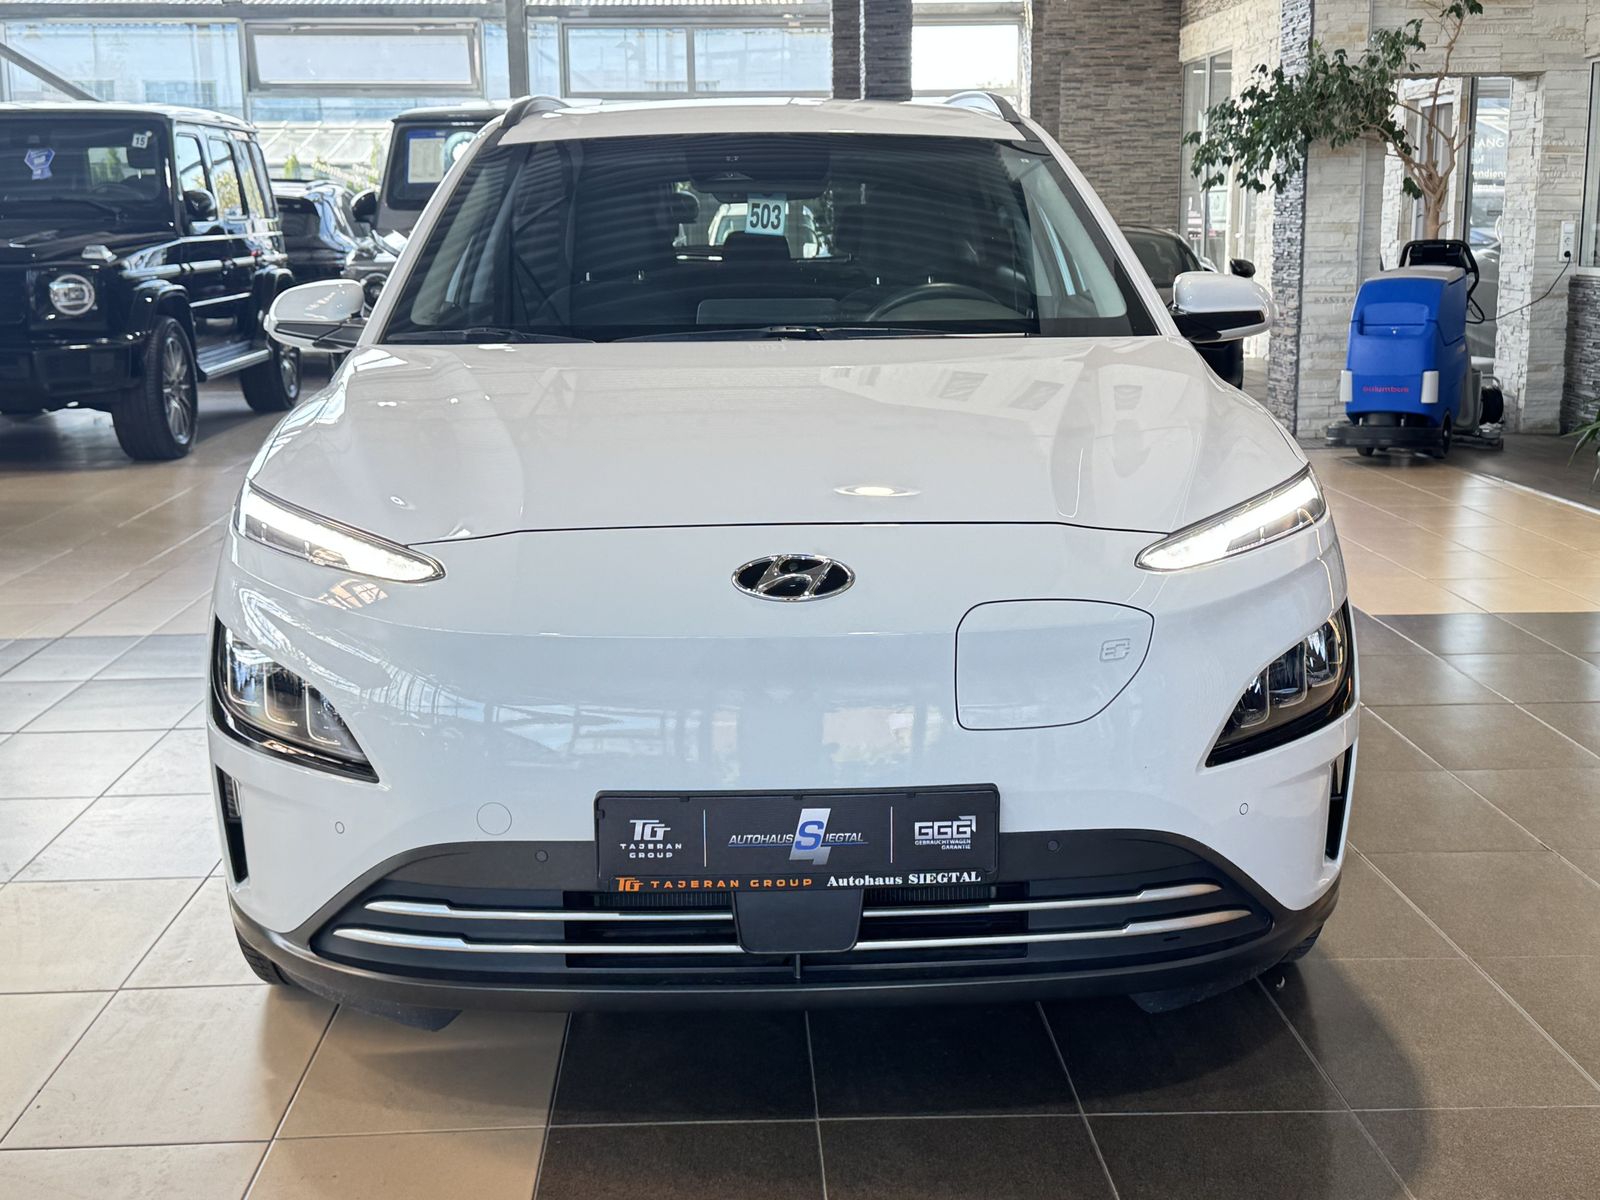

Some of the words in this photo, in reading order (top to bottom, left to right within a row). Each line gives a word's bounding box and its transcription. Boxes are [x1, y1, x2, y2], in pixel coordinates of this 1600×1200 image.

[135, 136, 146, 146] 15
[749, 202, 782, 230] 503
[914, 819, 972, 840] GGG
[728, 833, 795, 845] AUTOHAUS
[914, 838, 971, 846] GEBRAUCHTWAGEN
[650, 879, 740, 889] TAJERAN
[749, 878, 813, 888] GROUP
[826, 874, 903, 887] Autohaus
[907, 871, 982, 885] SIEGTAL
